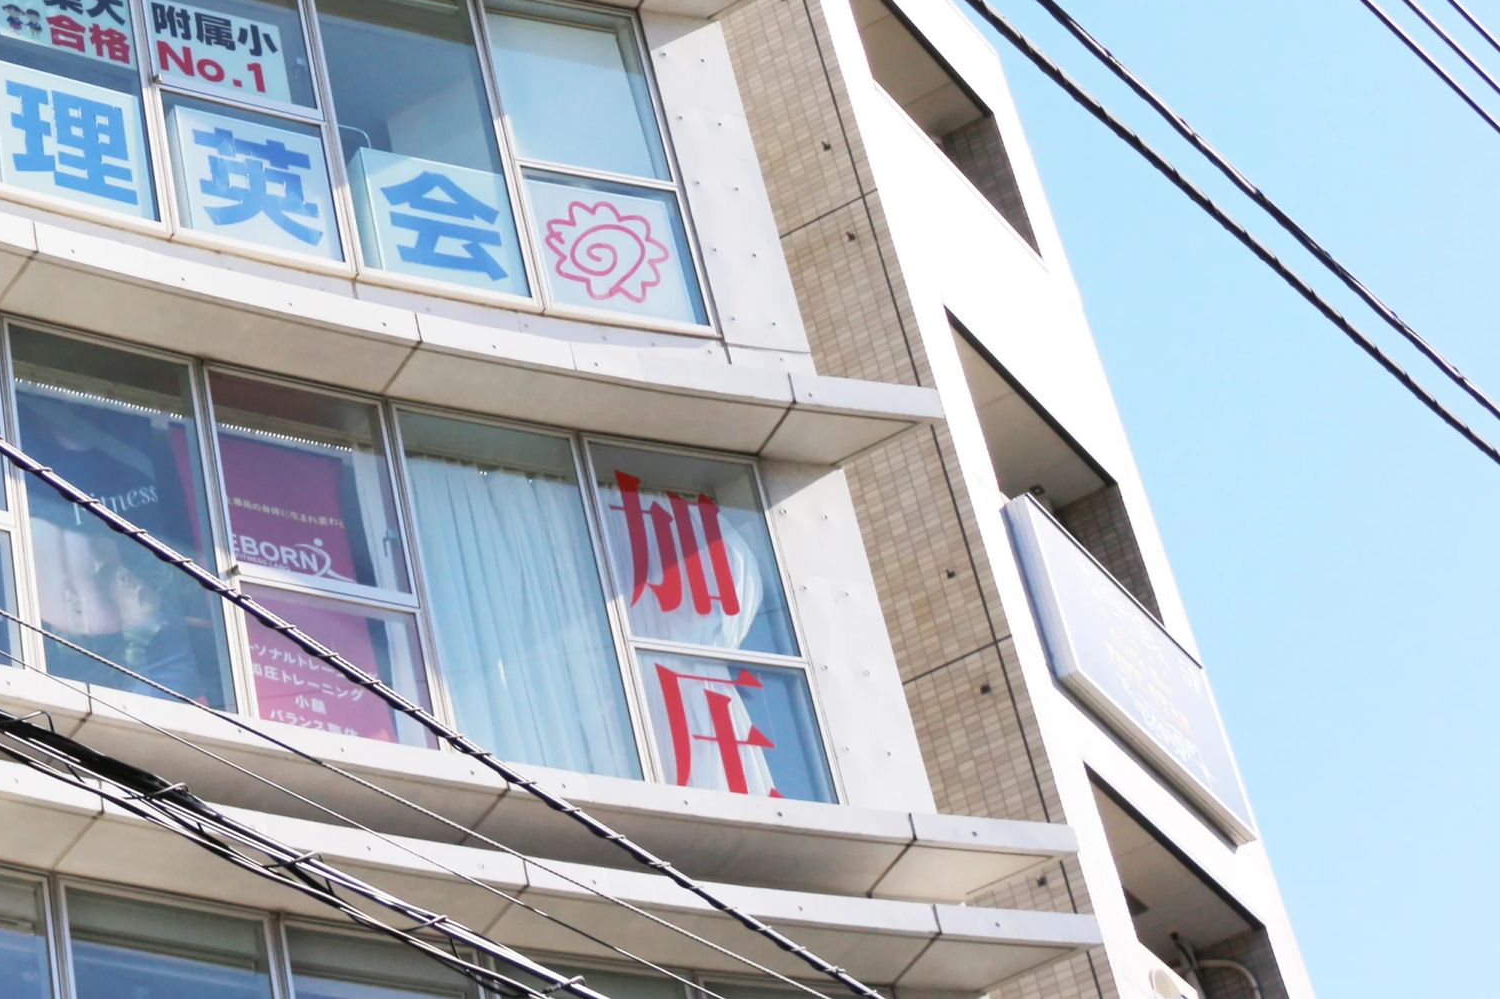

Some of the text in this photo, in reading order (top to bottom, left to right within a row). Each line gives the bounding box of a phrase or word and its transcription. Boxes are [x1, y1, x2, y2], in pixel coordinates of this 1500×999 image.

[46, 14, 266, 94] 合格 No.1
[151, 2, 278, 57] 附属小
[5, 80, 509, 282] 理英会
[72, 485, 158, 526] Fness
[609, 469, 785, 799] 加圧
